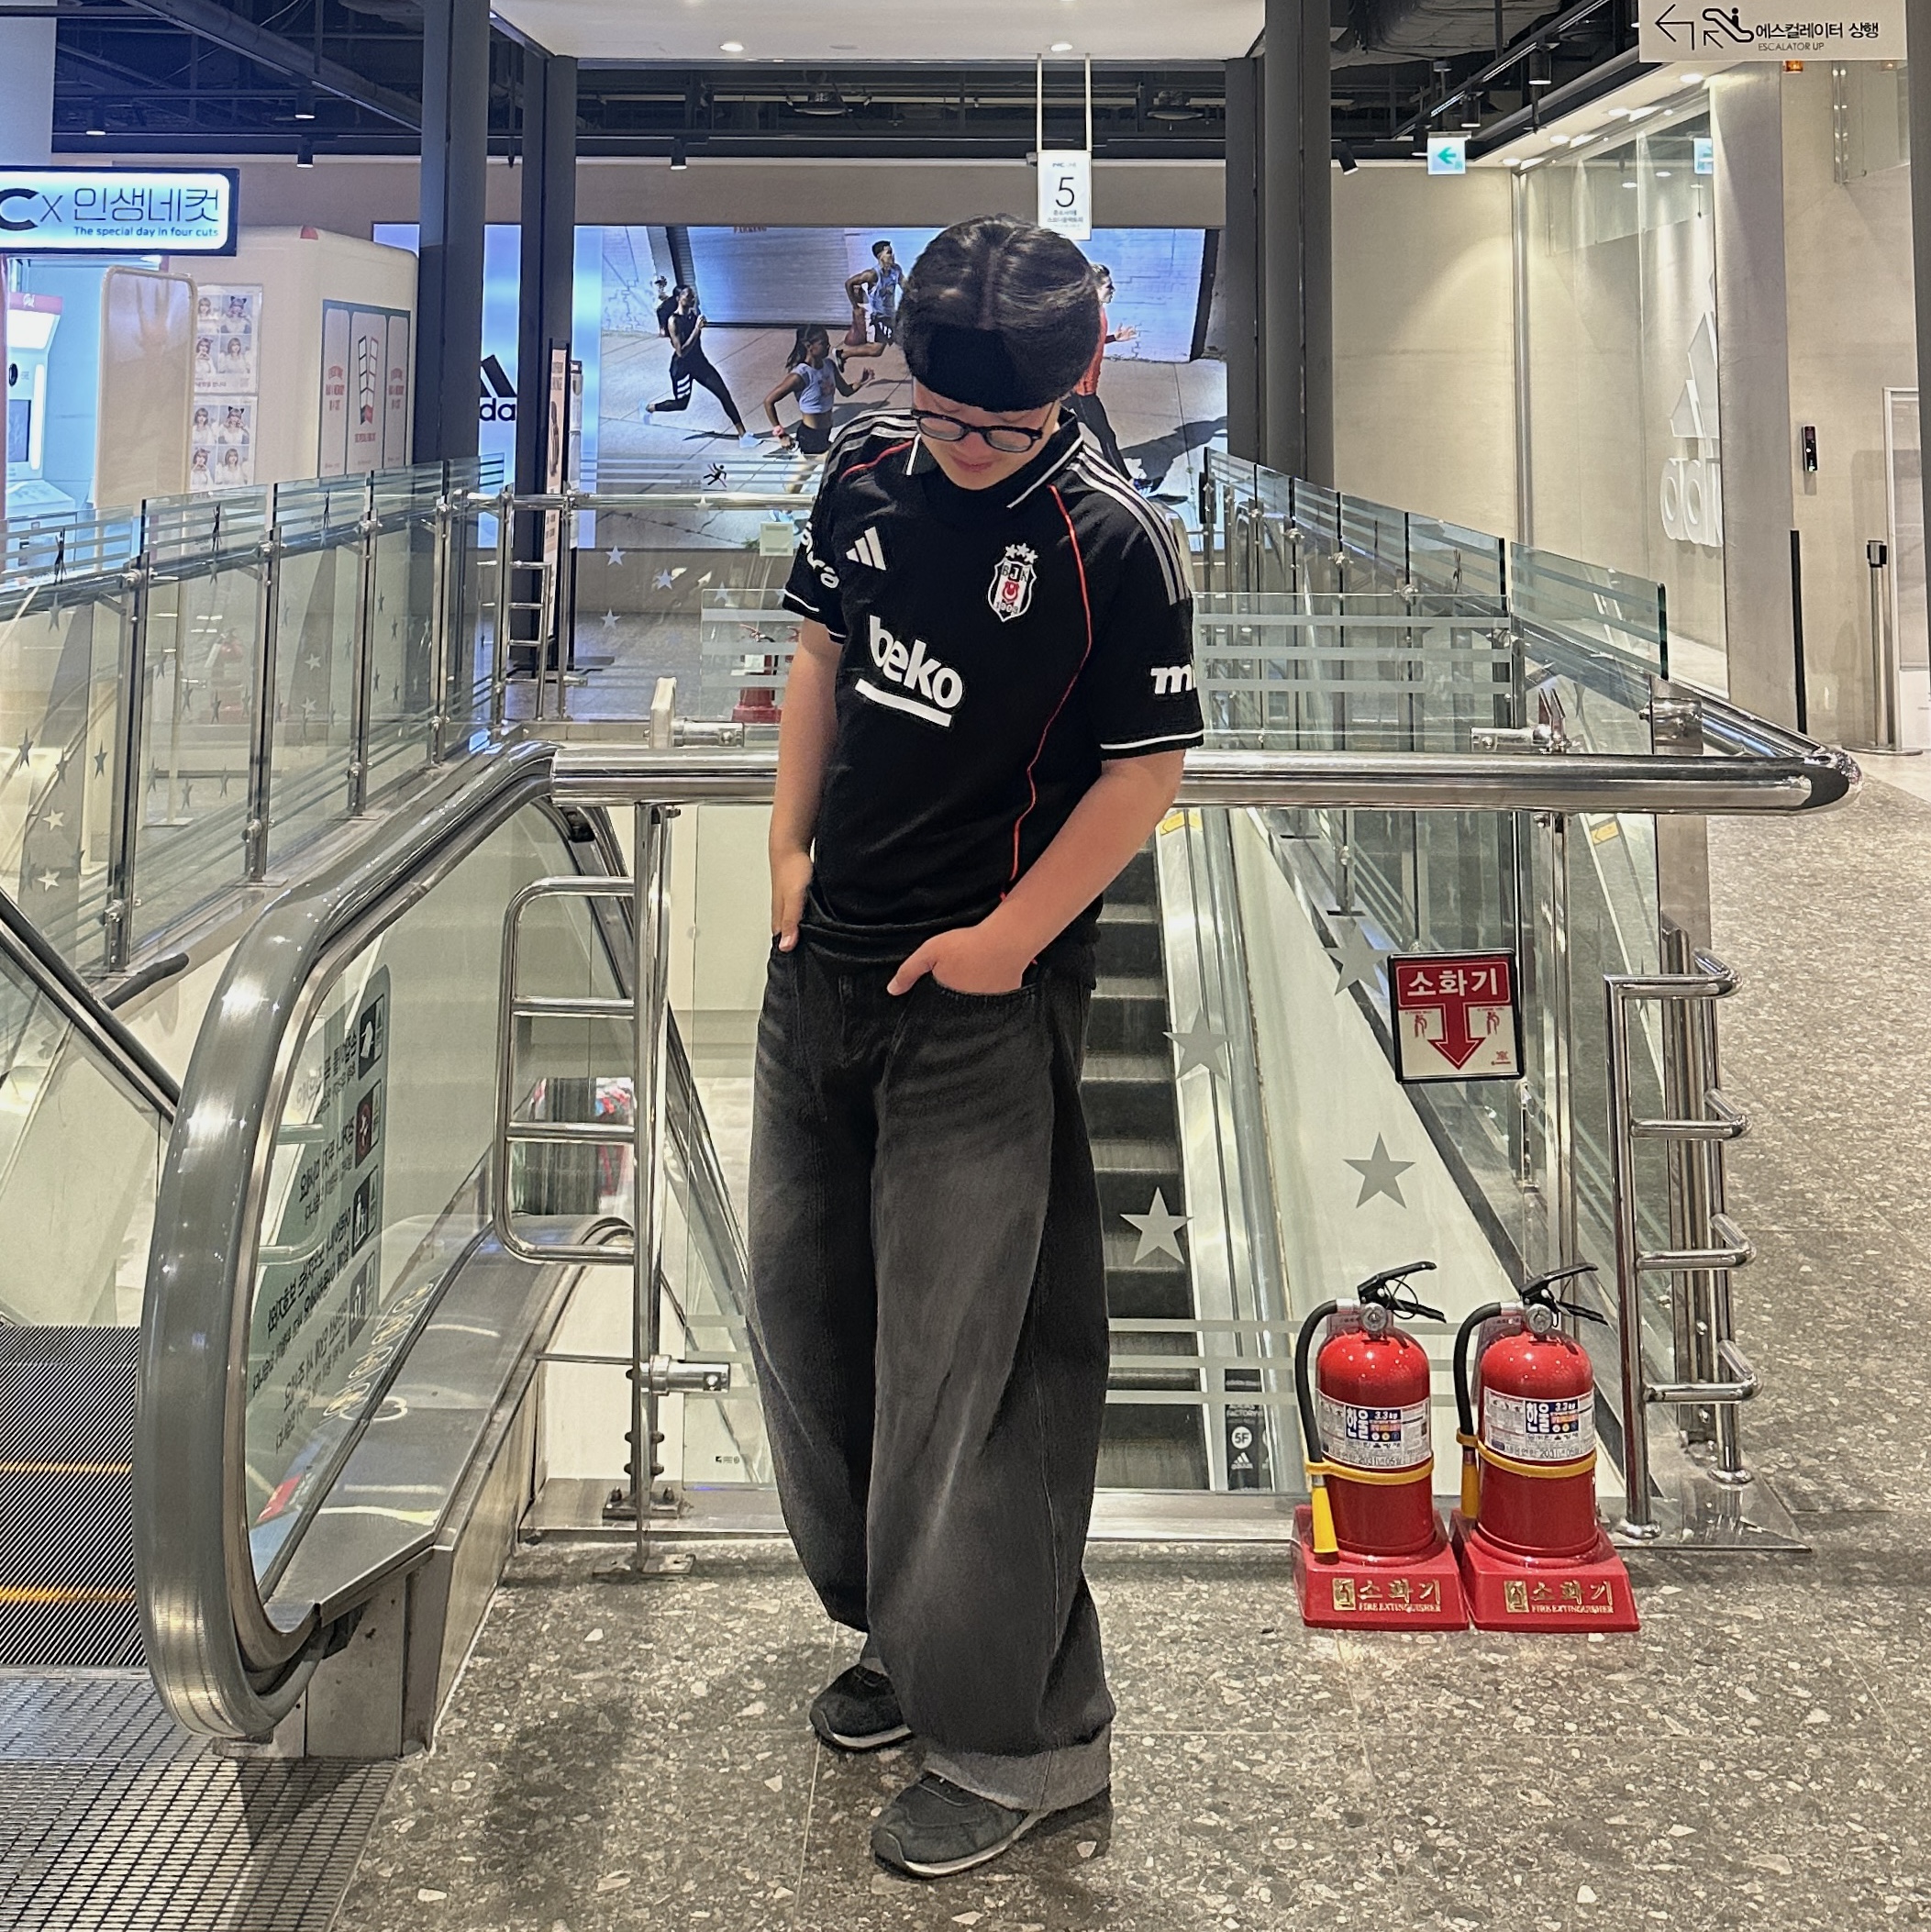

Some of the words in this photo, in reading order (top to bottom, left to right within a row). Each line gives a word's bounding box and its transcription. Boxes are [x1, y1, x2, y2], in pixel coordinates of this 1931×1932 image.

[1756, 22, 1843, 39] 에스컬레이터
[1848, 22, 1880, 39] 상행
[1759, 42, 1810, 51] ESCALATOR
[1813, 42, 1825, 50] UP
[73, 187, 219, 222] 인생네컷
[1056, 177, 1075, 207] 5
[74, 227, 95, 236] The
[96, 226, 133, 238] special
[137, 227, 154, 238] day
[158, 227, 168, 236] in
[171, 227, 193, 236] four
[195, 227, 219, 236] cuts
[870, 615, 963, 708] beko
[1407, 968, 1498, 996] 소화기
[1346, 1406, 1369, 1439] 한울
[1526, 1401, 1550, 1433] 한울
[1235, 1433, 1248, 1444] 5F
[1359, 1578, 1441, 1605] 소화기
[1530, 1580, 1614, 1606] 소화기
